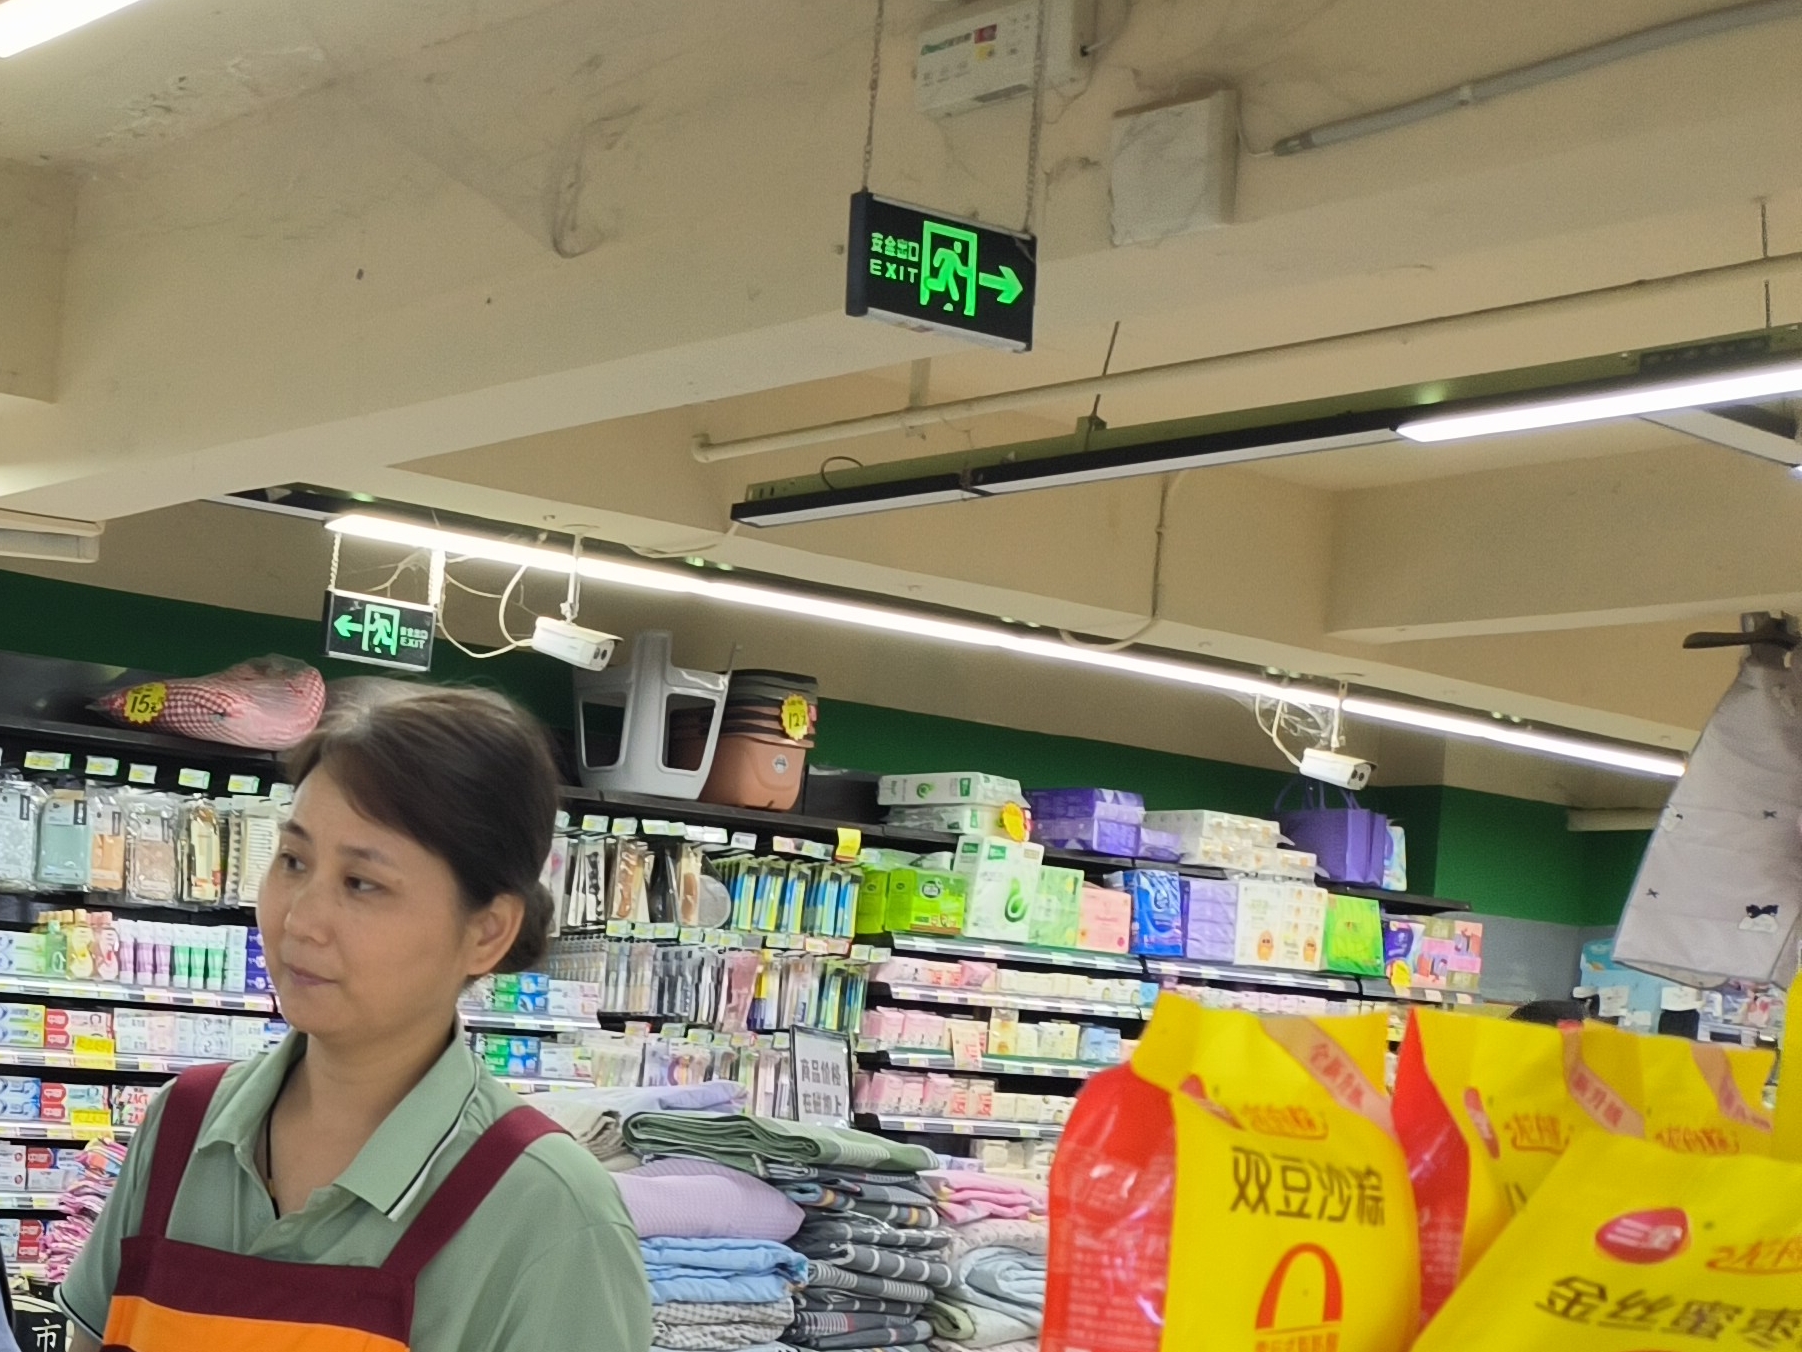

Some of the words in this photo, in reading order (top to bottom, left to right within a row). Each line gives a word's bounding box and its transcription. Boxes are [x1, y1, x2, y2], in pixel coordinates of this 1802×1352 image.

[870, 232, 919, 262] 安全出口
[869, 258, 918, 283] EXIT
[400, 636, 426, 649] EXIT
[1230, 1145, 1386, 1227] 双豆沙粽
